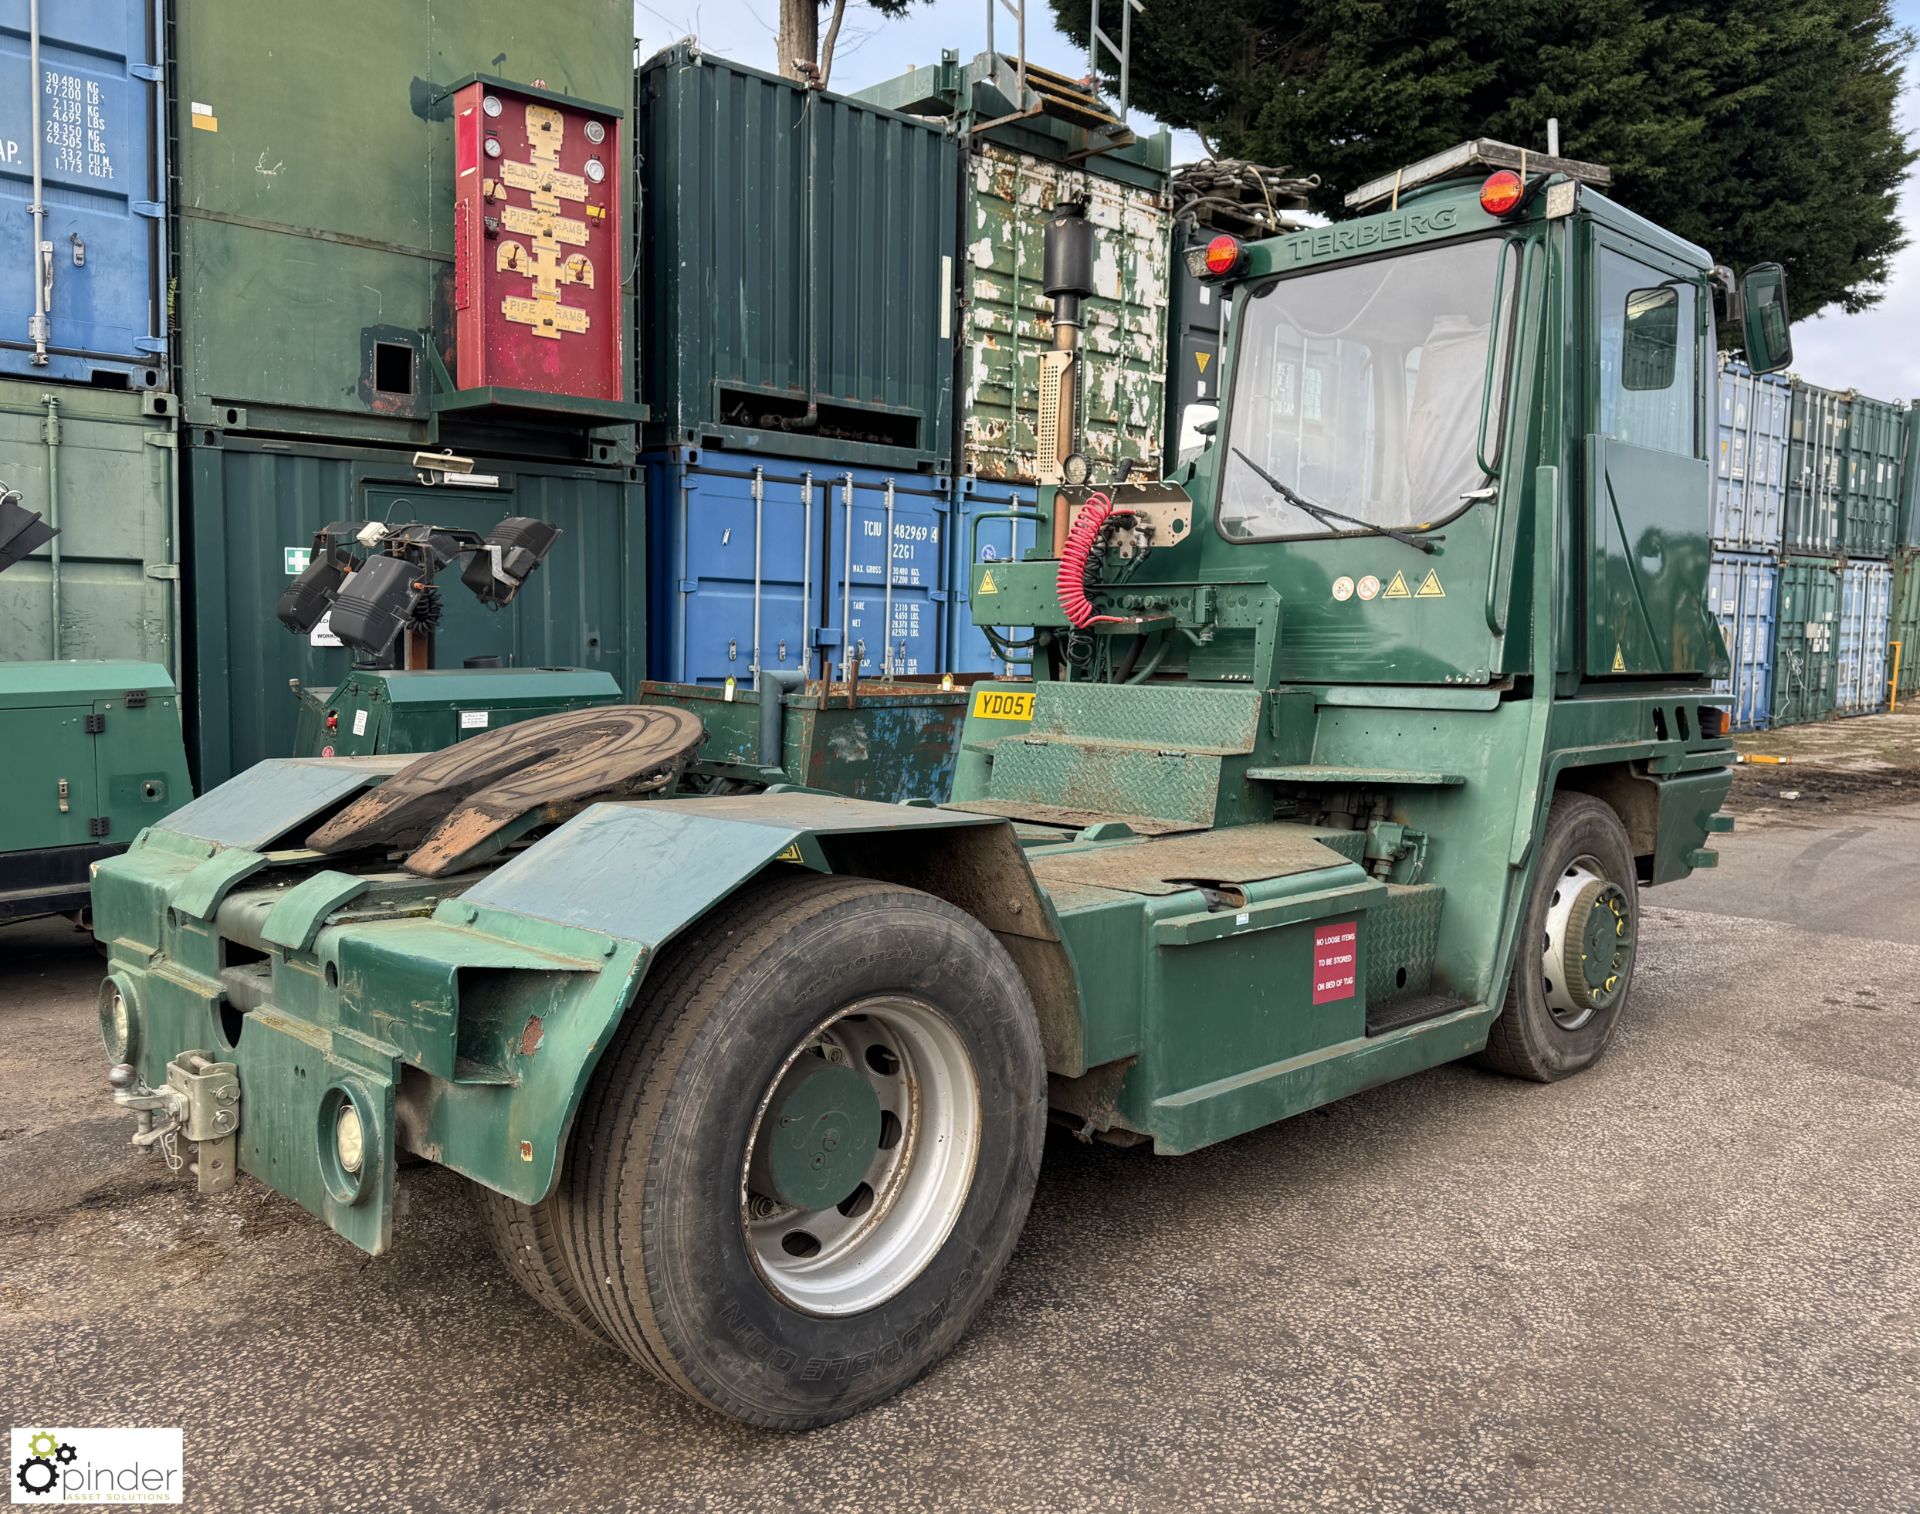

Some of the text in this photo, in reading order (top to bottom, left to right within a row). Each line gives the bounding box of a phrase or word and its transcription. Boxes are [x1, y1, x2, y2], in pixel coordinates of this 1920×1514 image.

[46, 72, 81, 89] 30.480
[46, 85, 81, 101] 67.200
[53, 98, 81, 114] 2.130
[53, 109, 105, 130] 4.695 LBS
[46, 121, 82, 138] 28.350
[46, 133, 106, 154] 62.505 LBS
[509, 210, 535, 225] PIPE
[556, 219, 583, 235] RAMS
[1284, 208, 1457, 261] TERBERG
[509, 300, 583, 322] PIPE RAMS
[864, 520, 938, 542] TCIU 482969 4
[893, 544, 914, 560] 22G1
[866, 565, 882, 574] GROSS
[853, 601, 865, 611] TARE
[852, 619, 861, 627] NET
[983, 694, 1024, 716] YD05
[1317, 933, 1356, 946] NO LOOSE ITEMS
[1318, 954, 1352, 967] TO BE STORED
[1317, 977, 1354, 991] ON BED OF TUG
[719, 1302, 799, 1374] COIN
